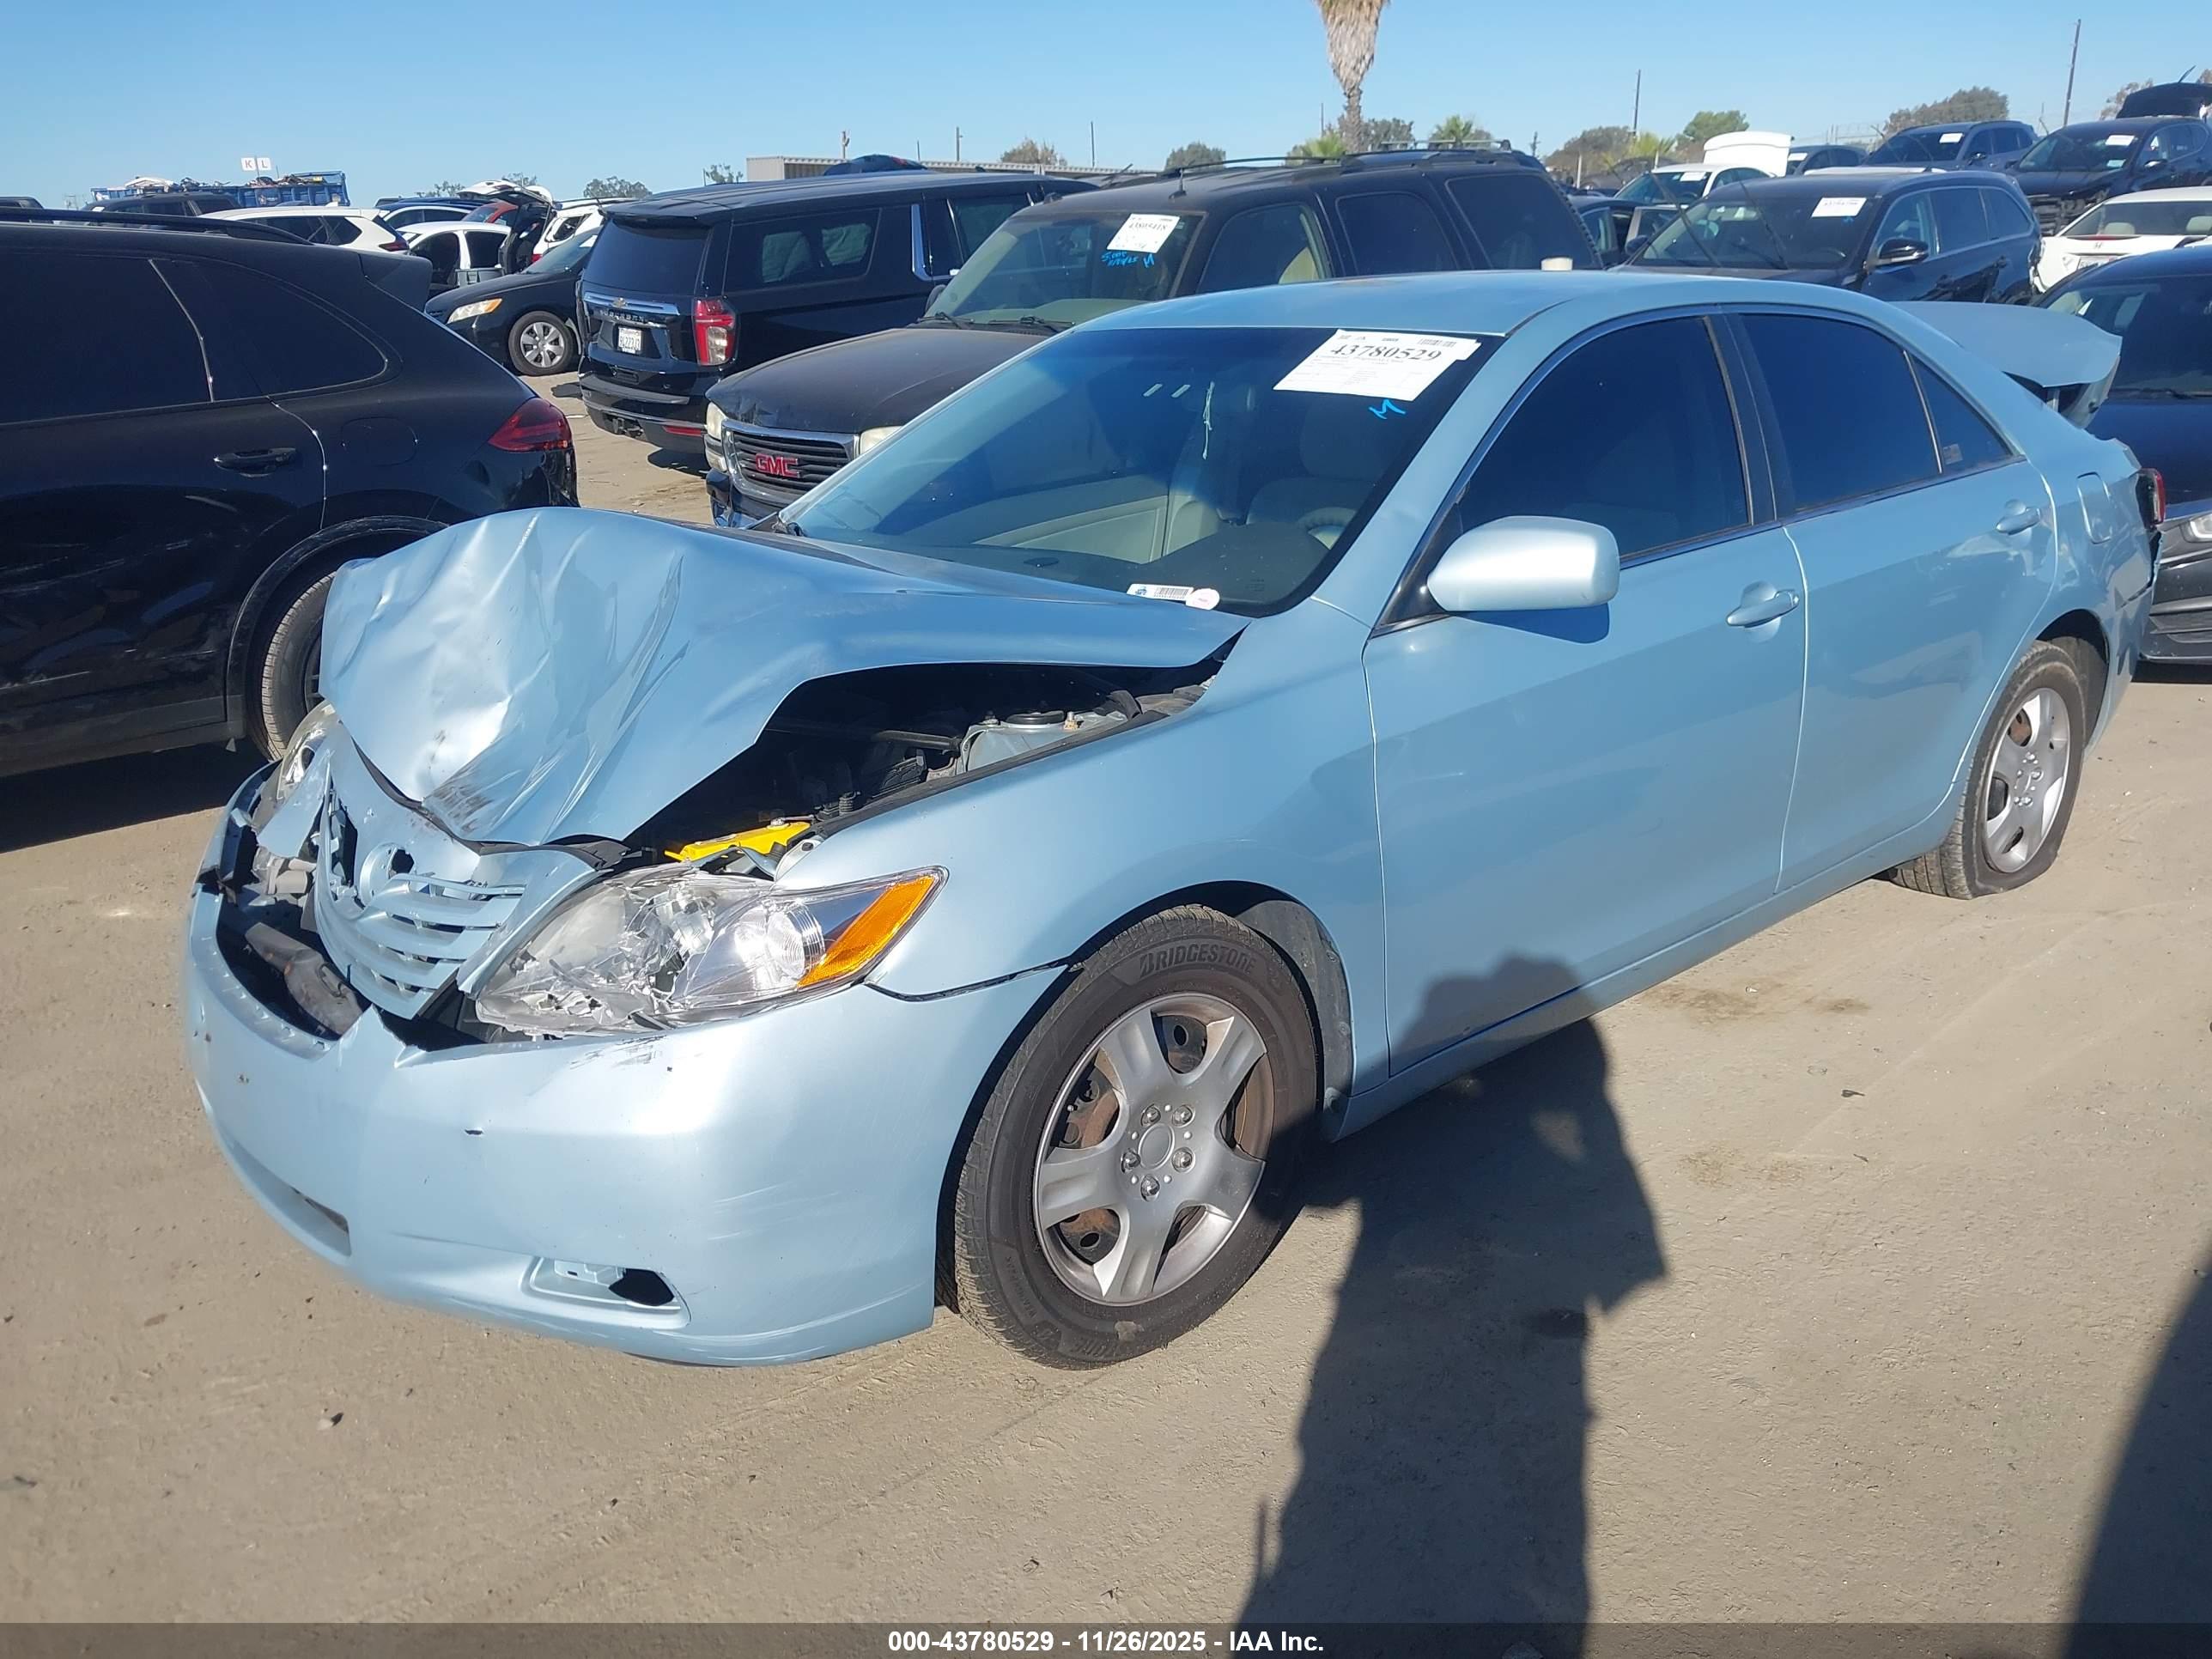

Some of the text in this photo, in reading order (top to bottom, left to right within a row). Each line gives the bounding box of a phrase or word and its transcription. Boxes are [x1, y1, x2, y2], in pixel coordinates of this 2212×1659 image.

[245, 160, 252, 168] K
[1330, 343, 1442, 361] 43780529
[756, 453, 800, 478] GMC
[1139, 944, 1257, 978] BRIDGESTONE
